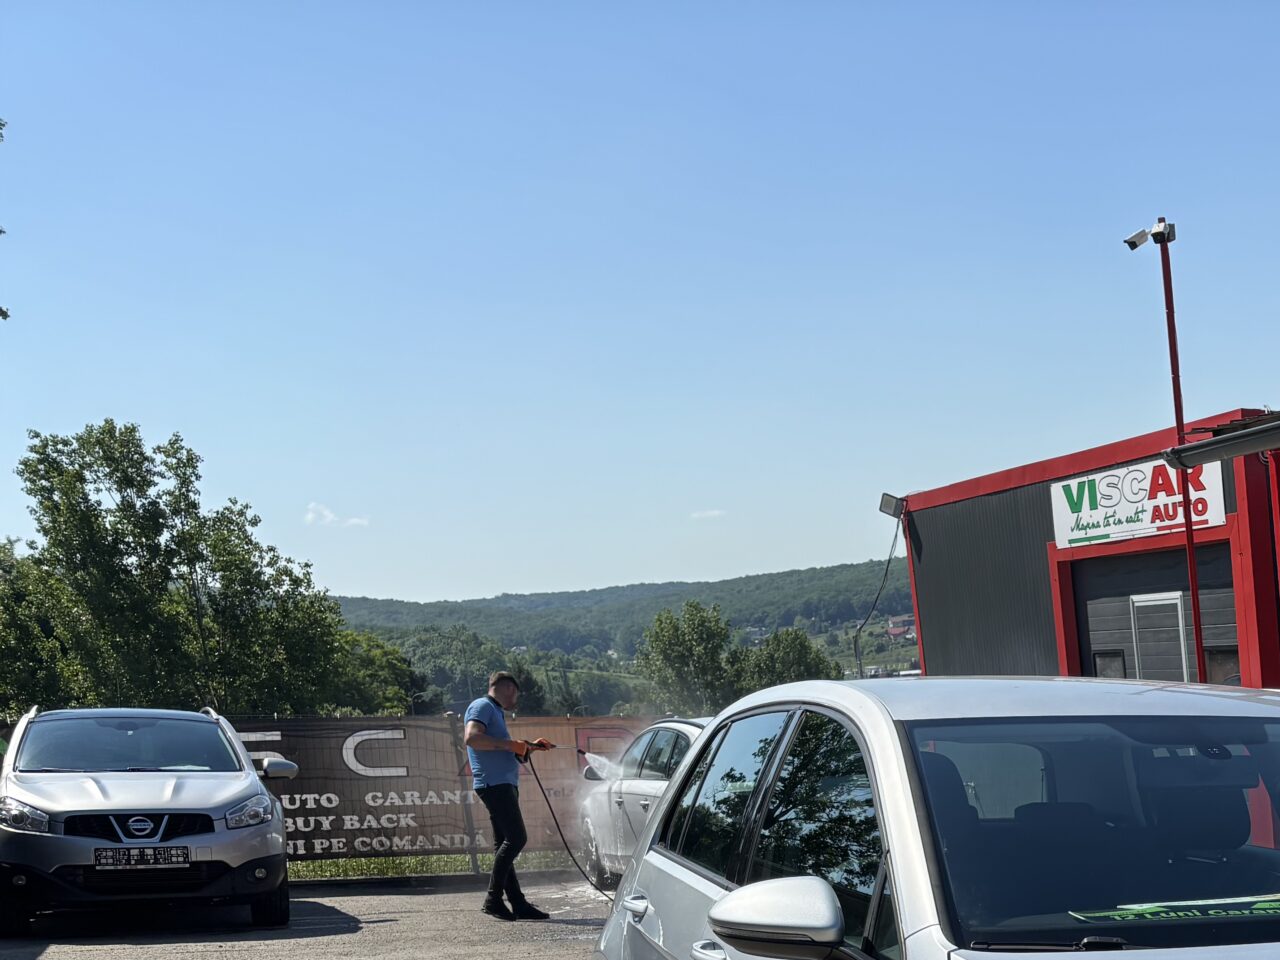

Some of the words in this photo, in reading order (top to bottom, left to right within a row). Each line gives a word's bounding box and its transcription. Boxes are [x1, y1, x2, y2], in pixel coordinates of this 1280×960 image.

[1062, 463, 1206, 514] VISCAR
[1150, 497, 1208, 524] AUO
[280, 793, 340, 810] UTO
[364, 789, 485, 807] GARANT
[284, 815, 336, 832] BUY
[342, 813, 418, 830] BACK
[312, 837, 348, 854] PE
